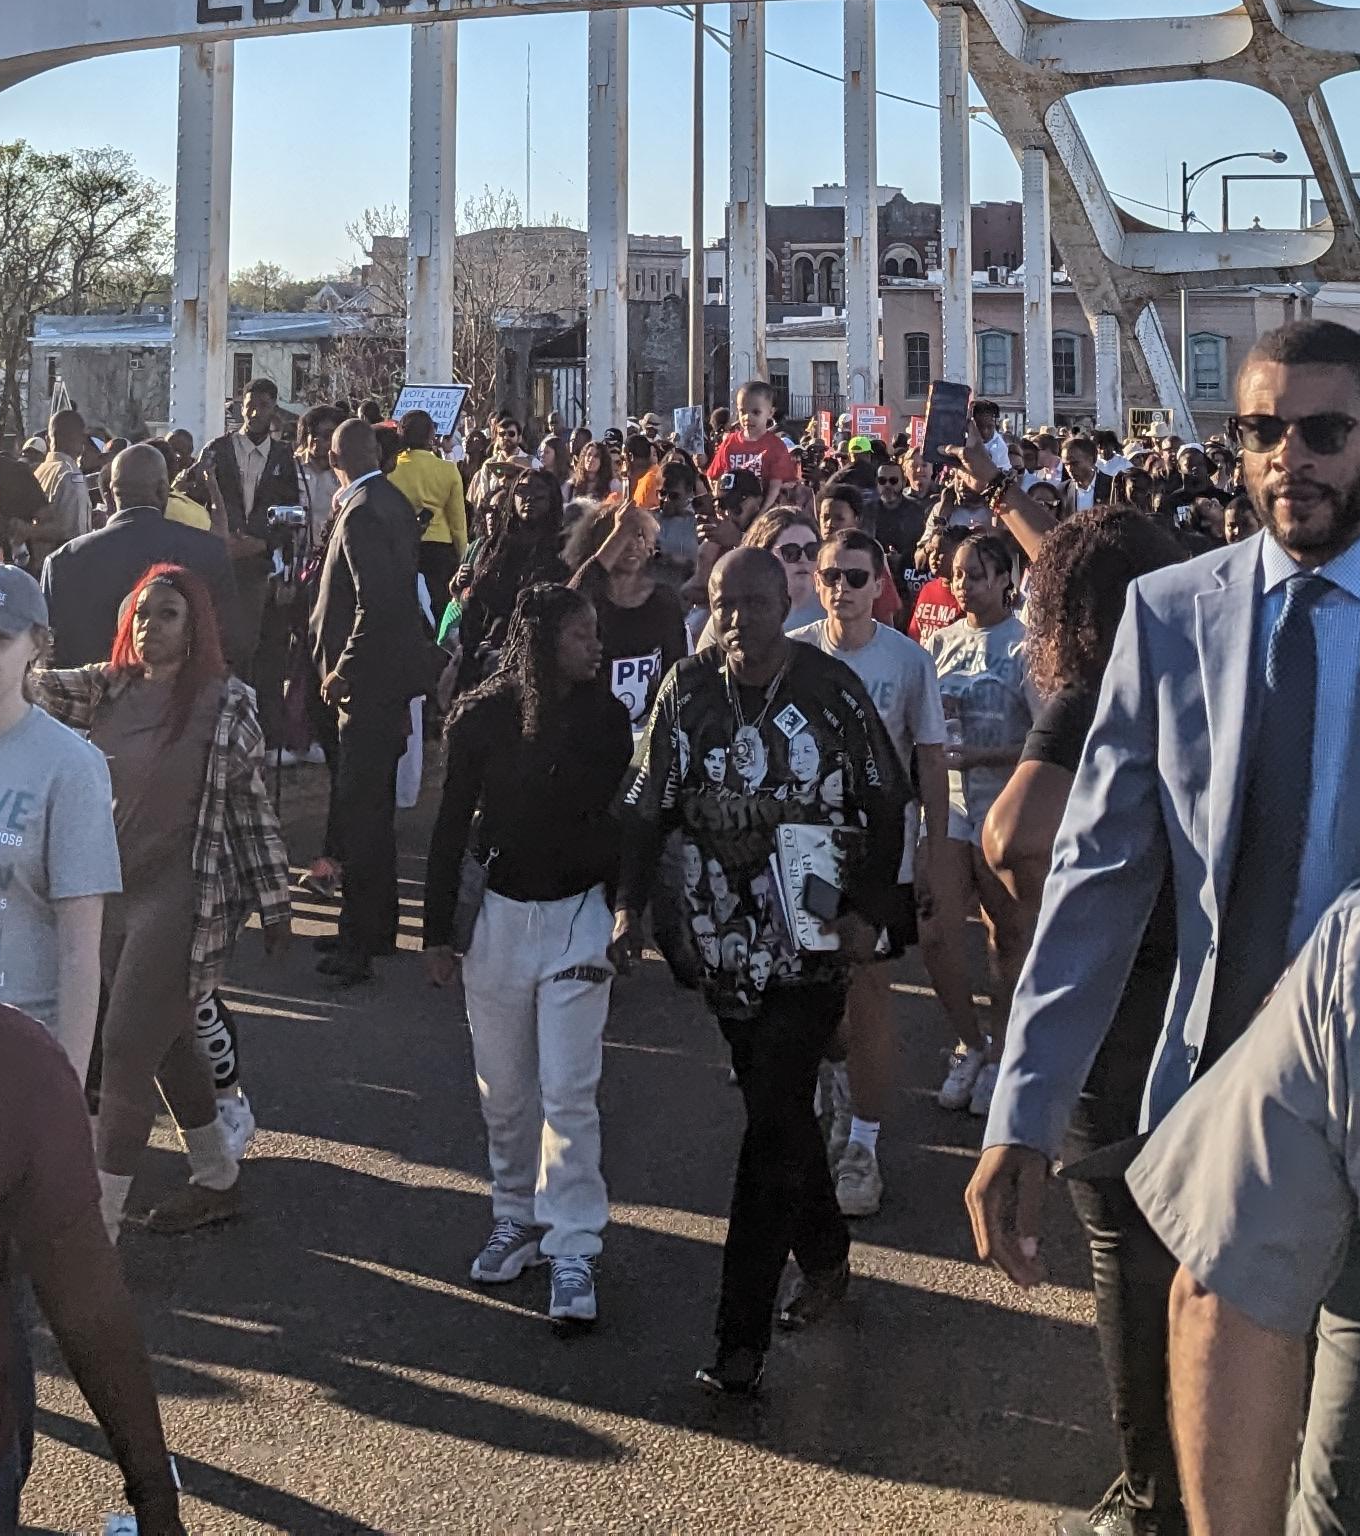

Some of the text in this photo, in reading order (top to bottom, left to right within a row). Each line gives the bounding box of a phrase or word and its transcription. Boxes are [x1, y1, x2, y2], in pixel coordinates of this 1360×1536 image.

[404, 390, 427, 398] VOTE
[400, 400, 423, 408] VOTE
[729, 453, 762, 468] SELMA
[914, 603, 956, 622] SELMA
